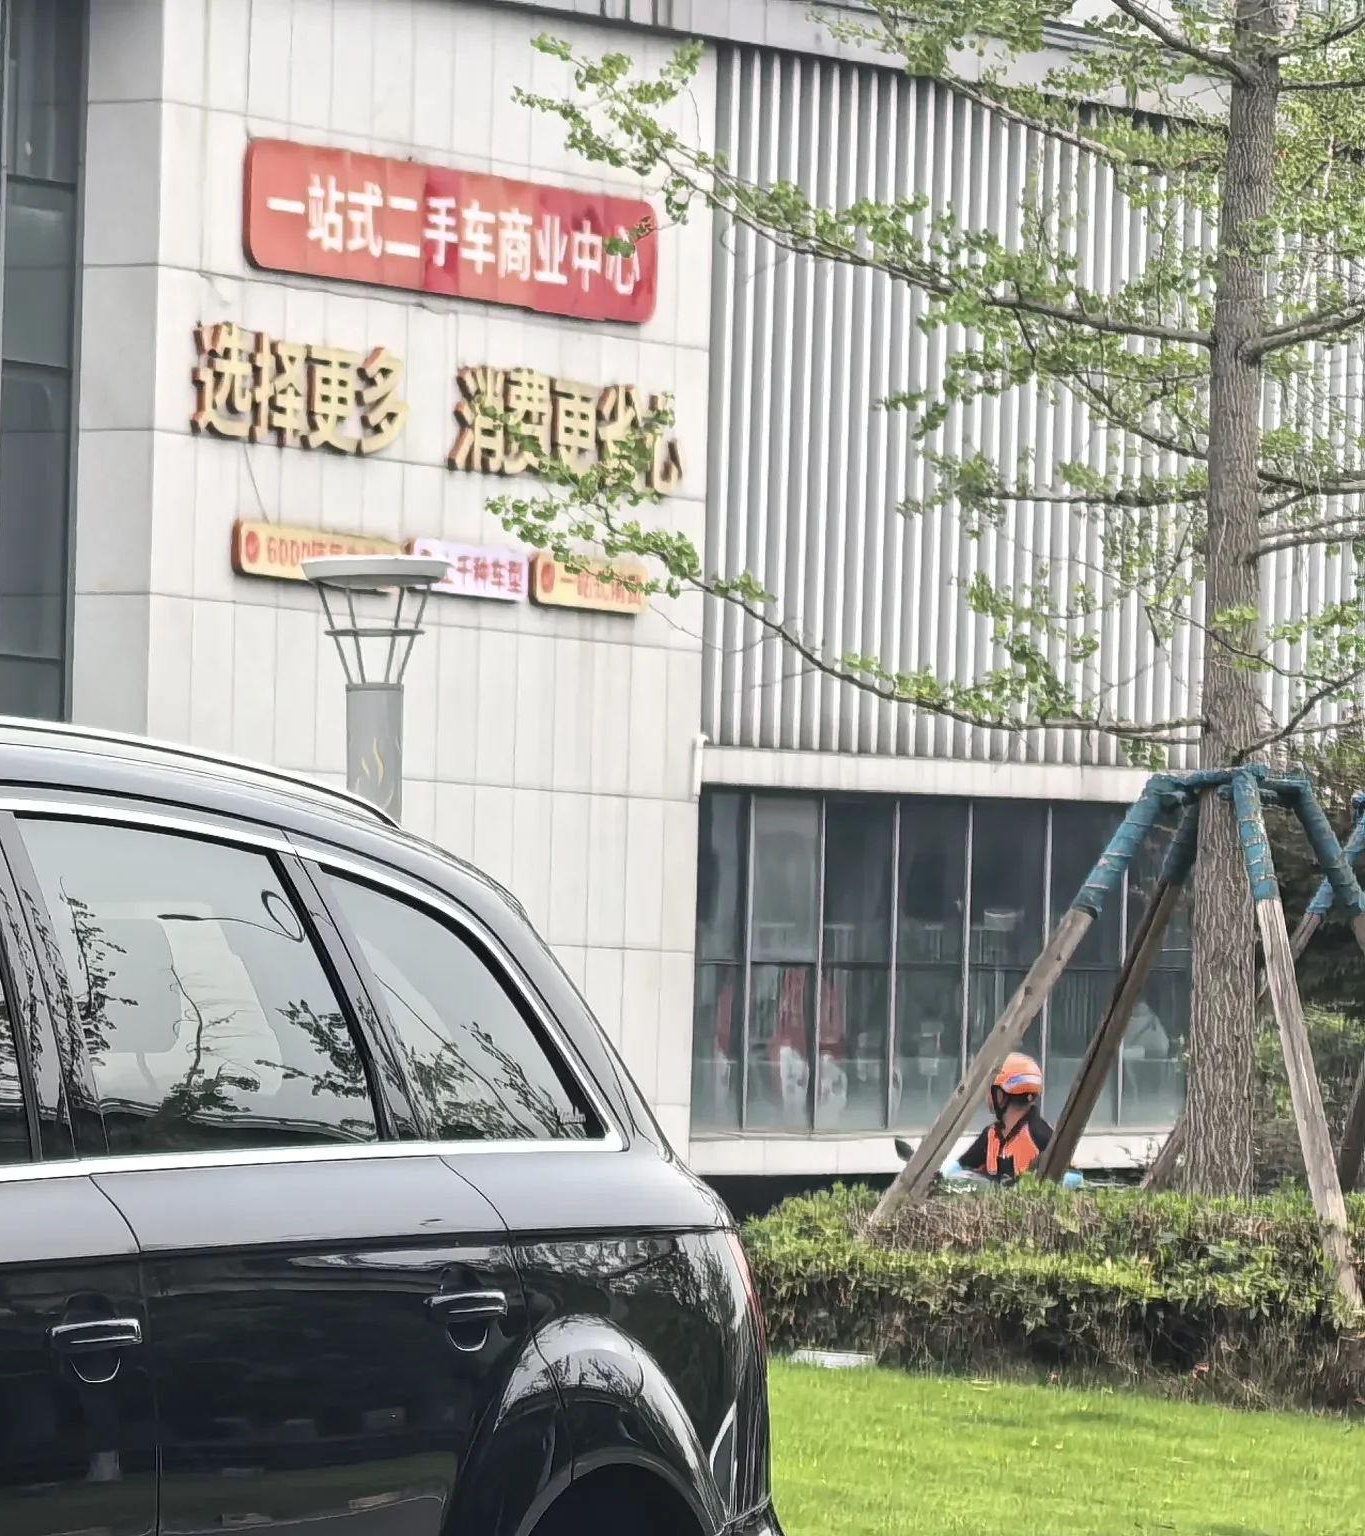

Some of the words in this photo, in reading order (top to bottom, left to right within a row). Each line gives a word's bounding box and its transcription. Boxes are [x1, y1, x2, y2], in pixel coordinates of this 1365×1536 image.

[266, 172, 641, 295] 一站式二手车商业中心
[190, 321, 409, 456] 选择更多
